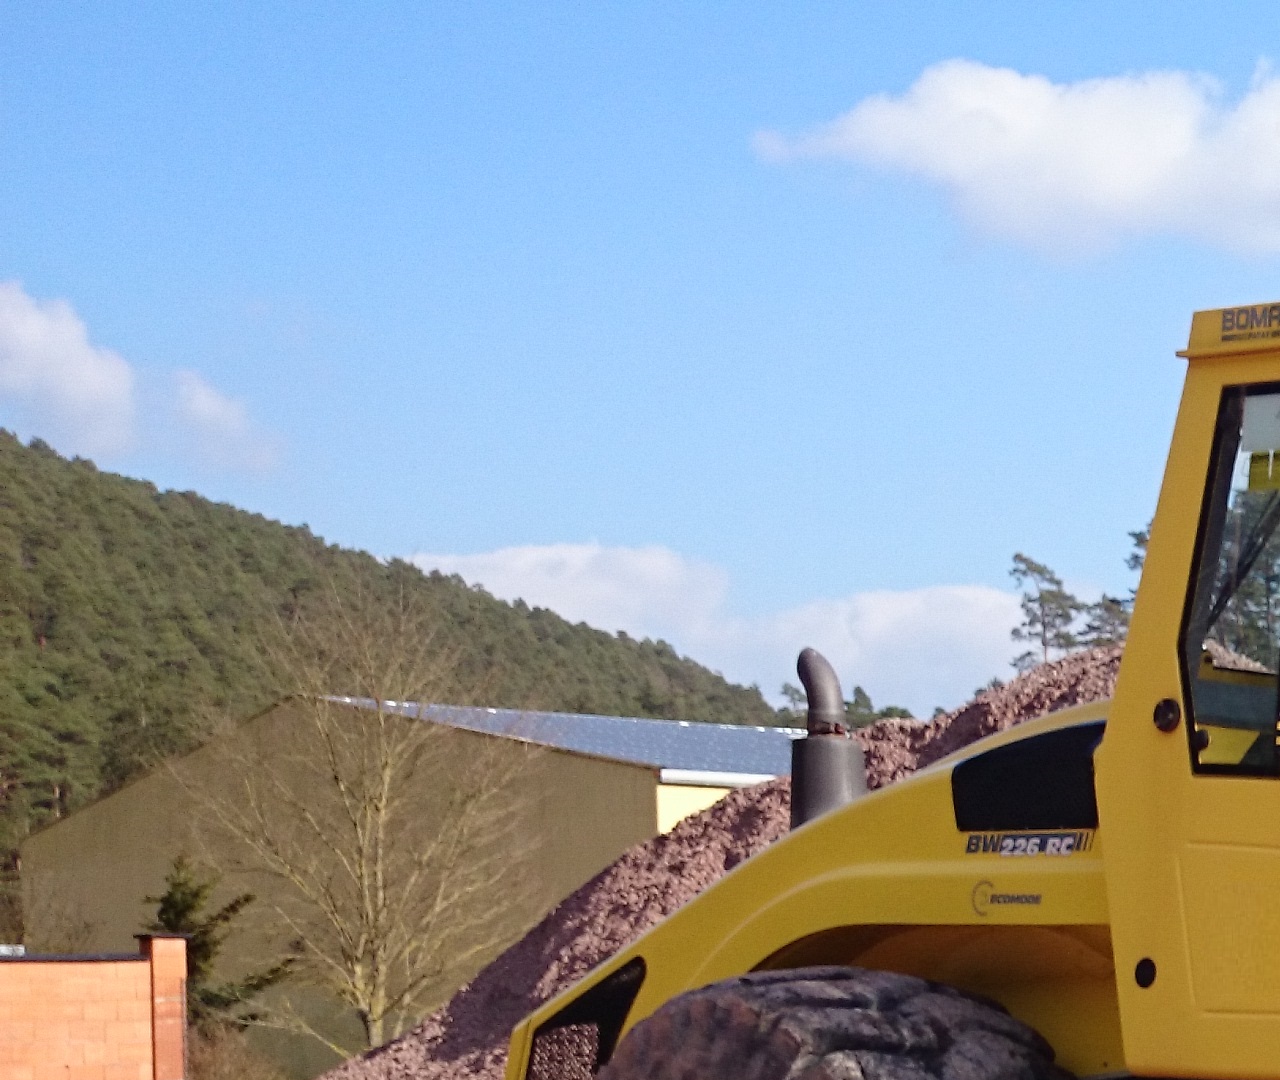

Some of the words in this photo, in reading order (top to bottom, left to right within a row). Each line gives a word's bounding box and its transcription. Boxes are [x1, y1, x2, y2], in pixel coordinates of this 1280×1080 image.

[966, 835, 1001, 854] BW
[1000, 836, 1040, 857] 226
[1045, 836, 1075, 857] RC
